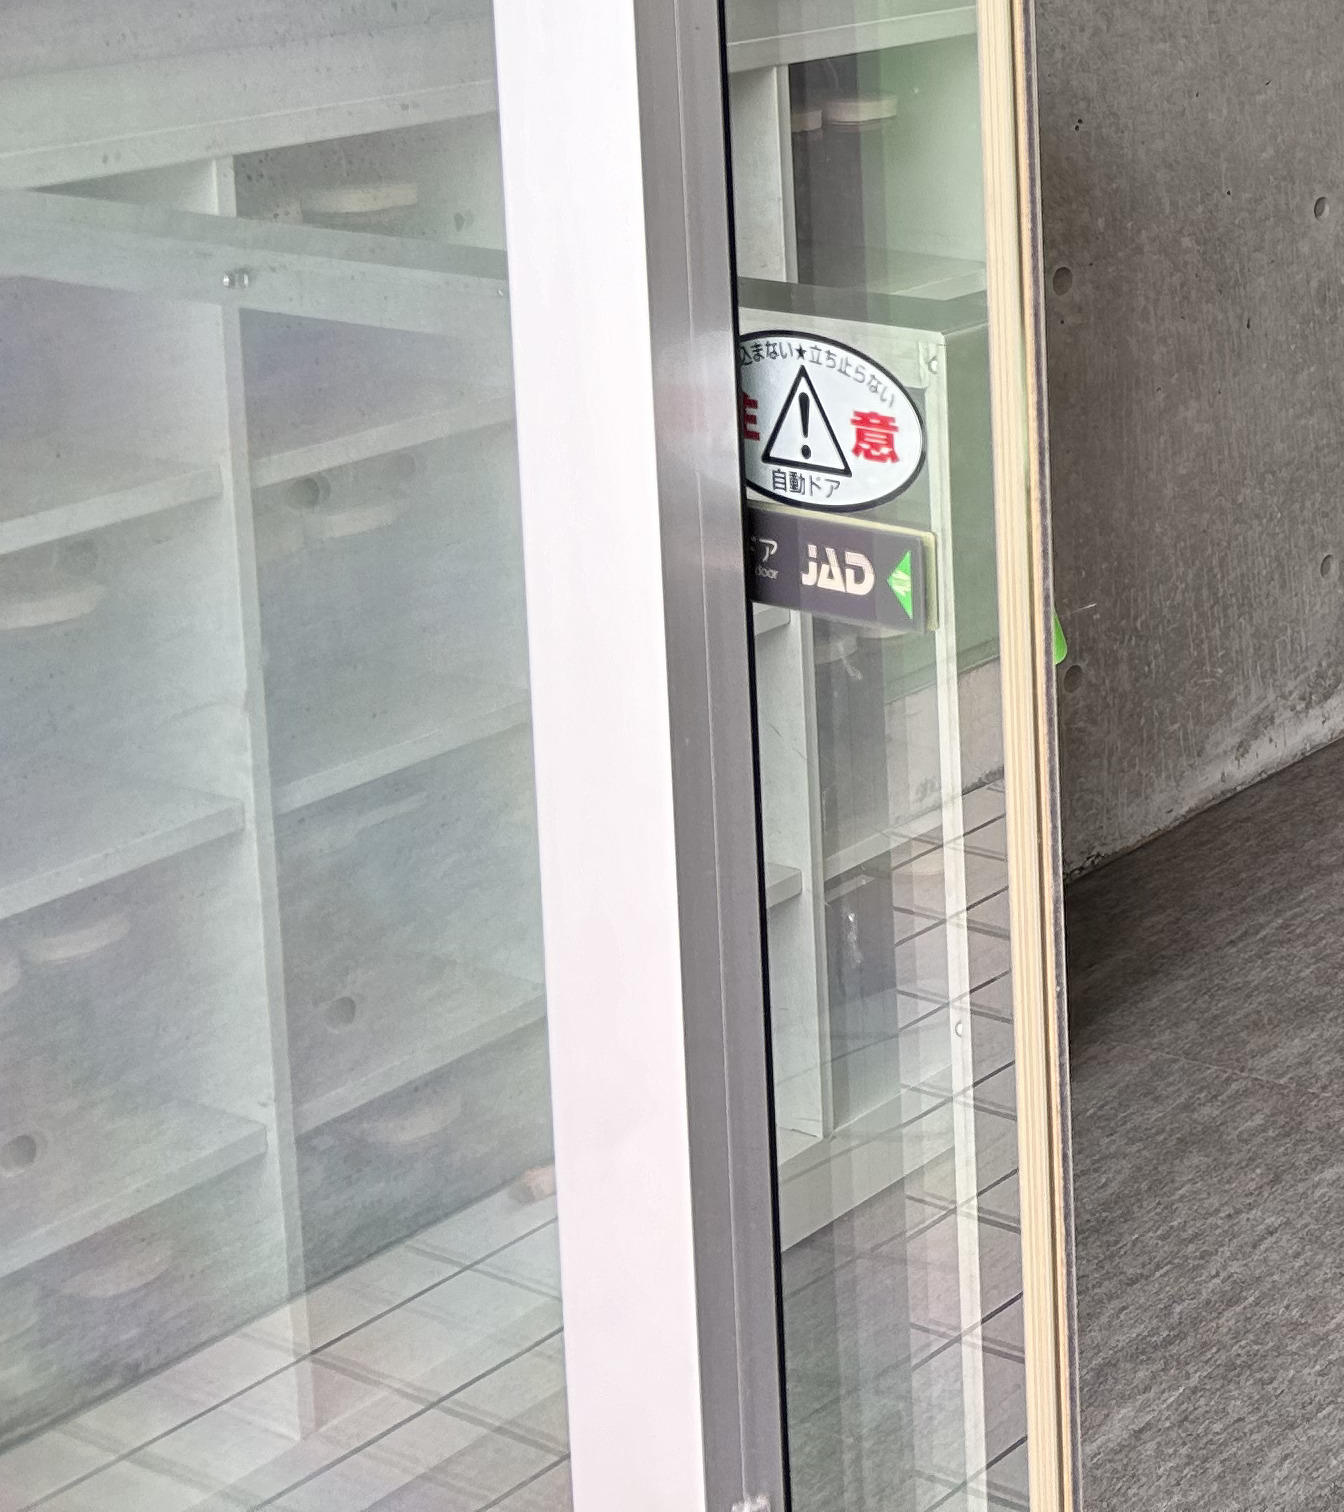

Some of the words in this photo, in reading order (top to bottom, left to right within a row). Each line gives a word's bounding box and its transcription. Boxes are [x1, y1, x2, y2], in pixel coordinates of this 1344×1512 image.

[850, 410, 900, 464] 意
[771, 467, 841, 499] 自動ドア
